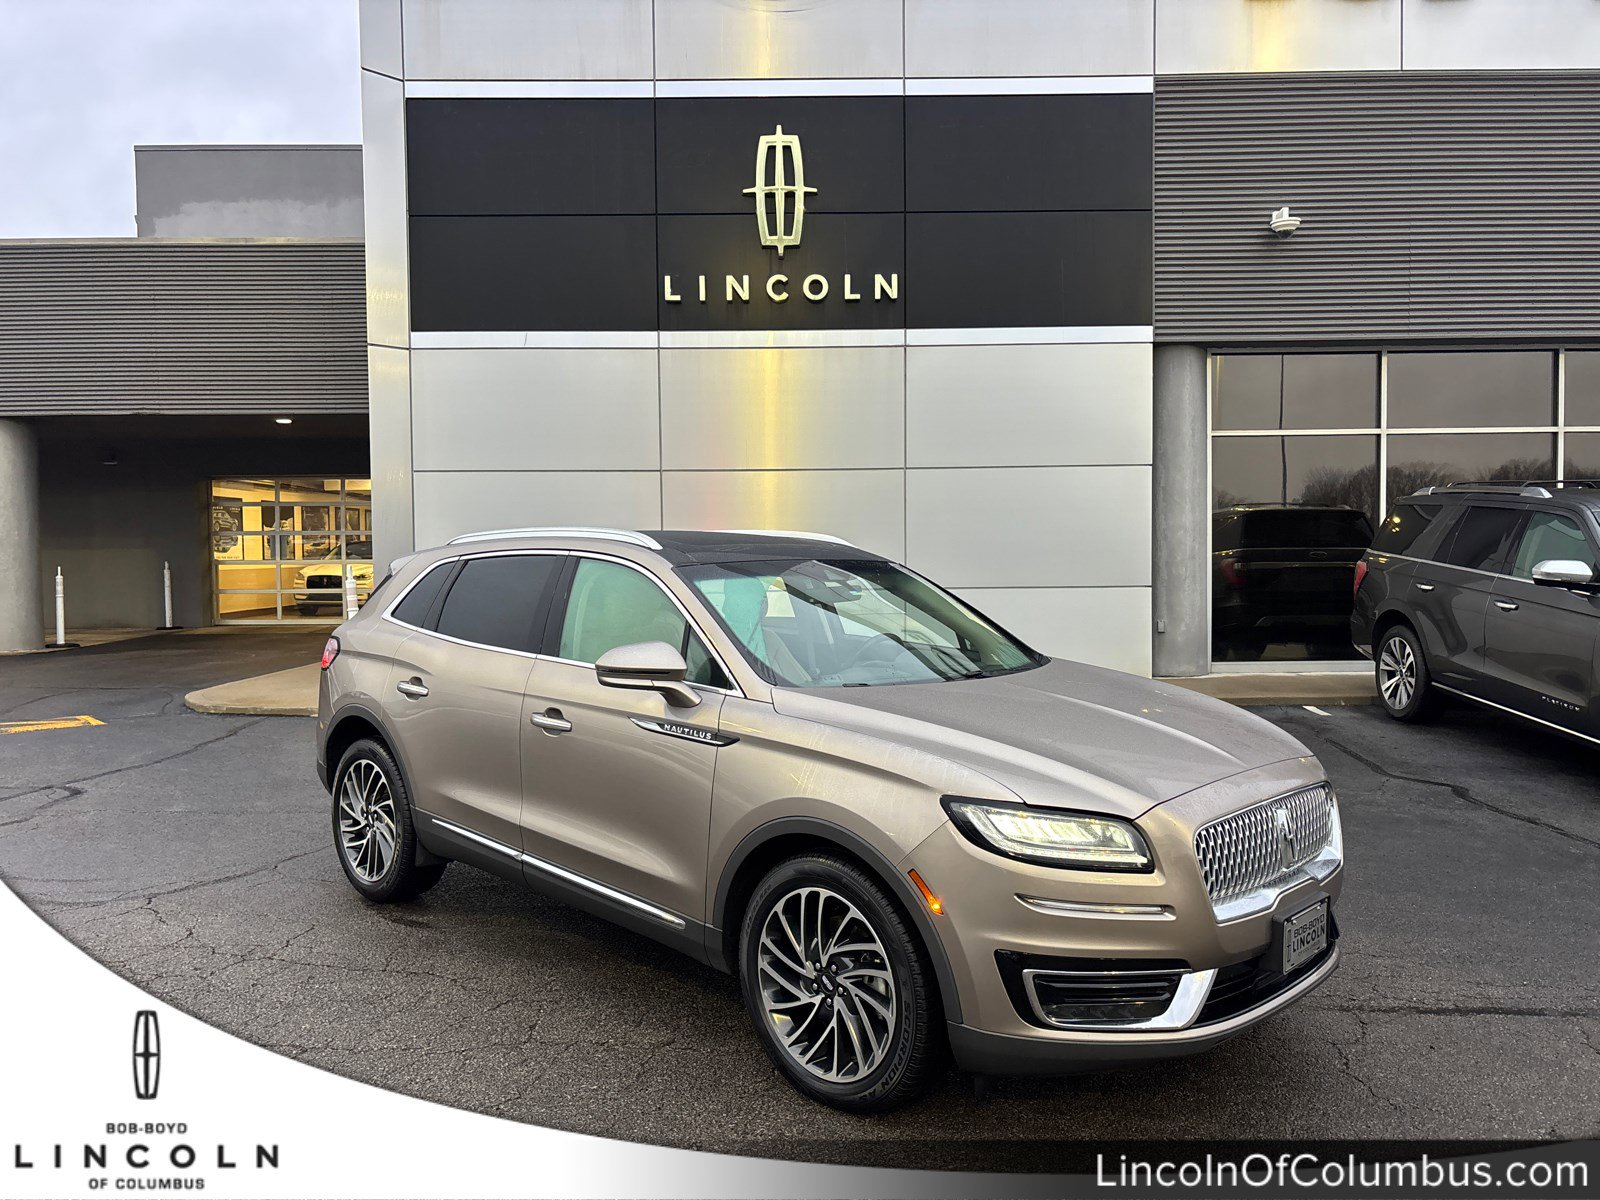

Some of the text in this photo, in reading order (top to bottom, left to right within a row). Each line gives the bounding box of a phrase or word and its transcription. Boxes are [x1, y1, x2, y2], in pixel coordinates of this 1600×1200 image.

[664, 273, 898, 302] LINCOLN
[664, 724, 712, 740] NAUTILUS
[1292, 924, 1325, 953] LINCOLN
[1293, 914, 1325, 938] BOB-BOYD
[881, 1001, 912, 1091] SCORPION
